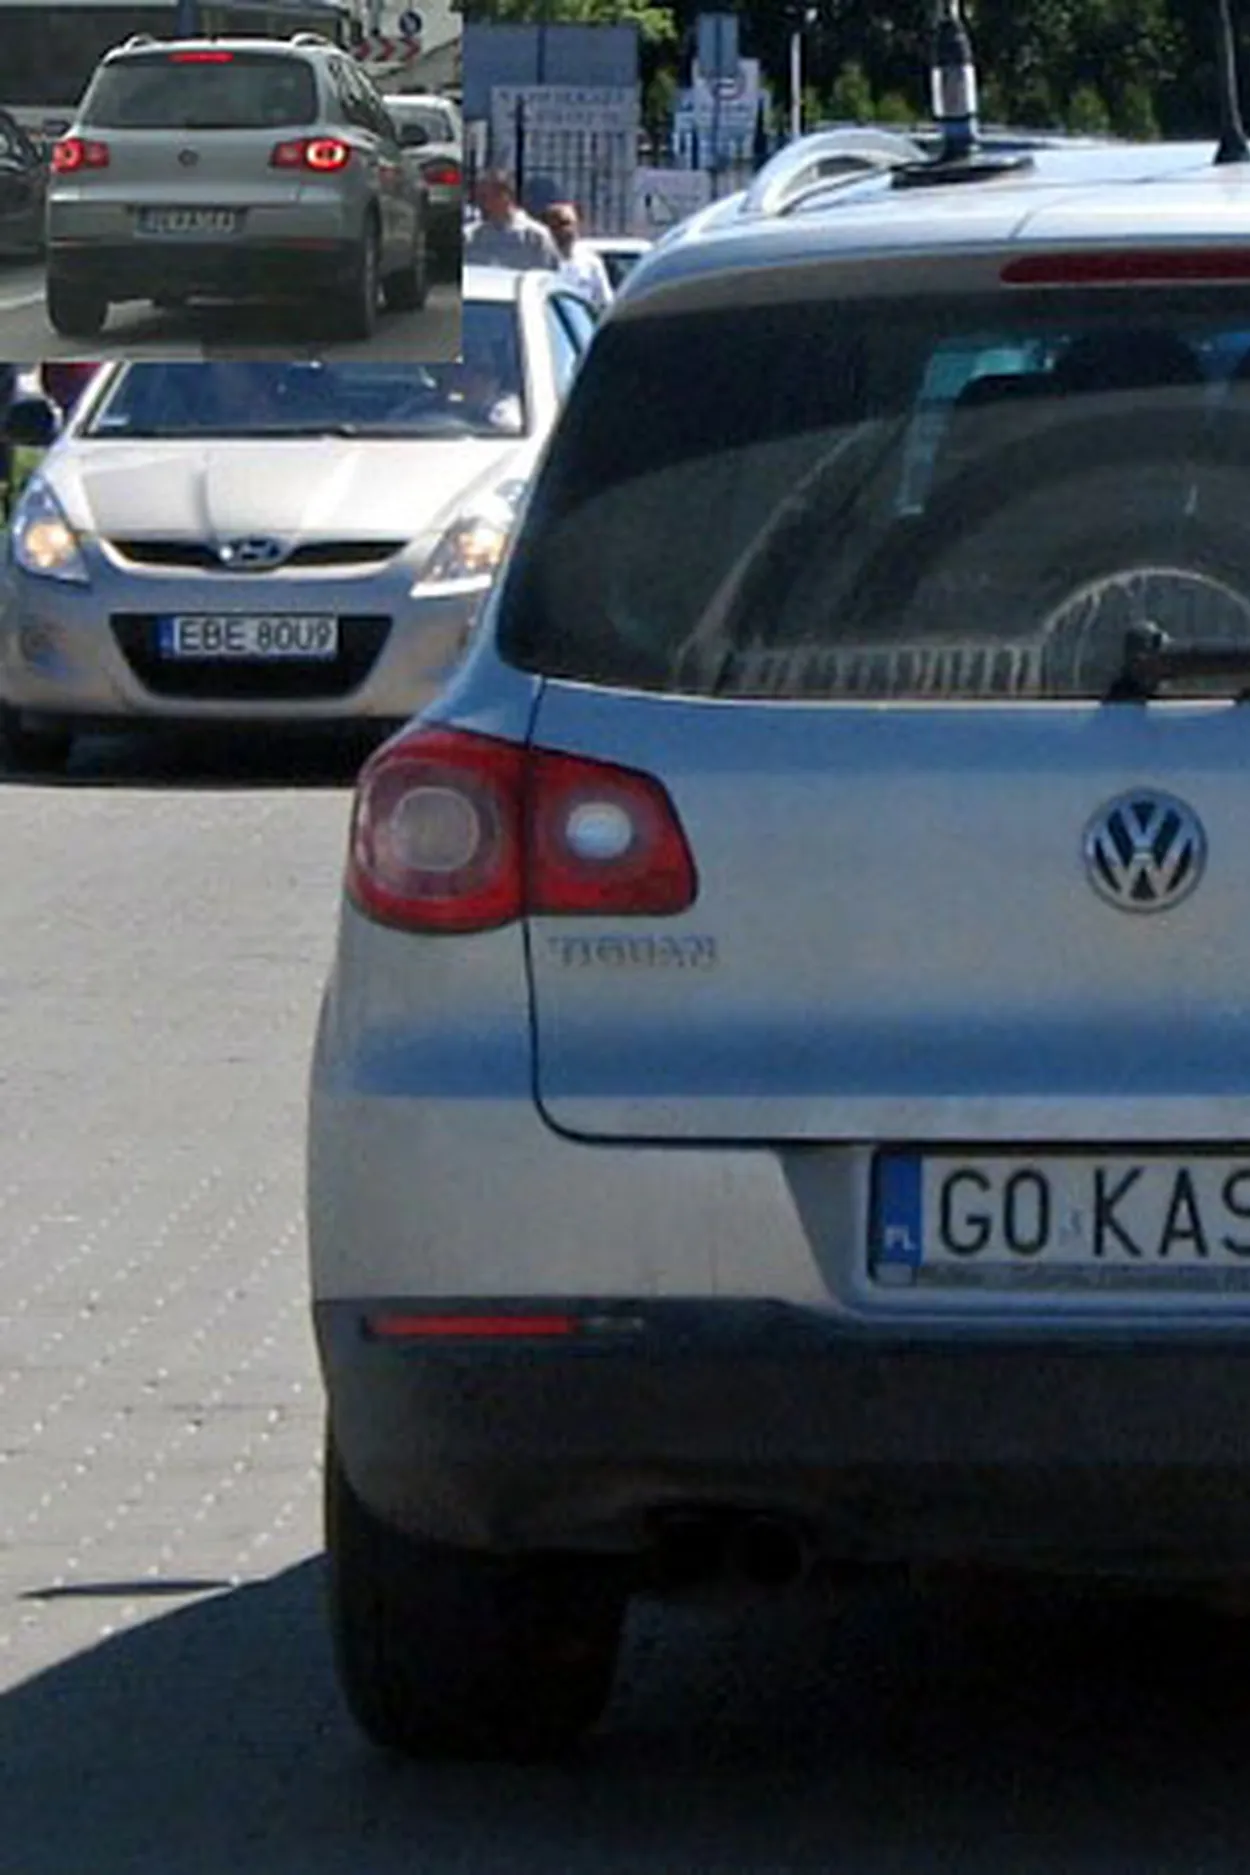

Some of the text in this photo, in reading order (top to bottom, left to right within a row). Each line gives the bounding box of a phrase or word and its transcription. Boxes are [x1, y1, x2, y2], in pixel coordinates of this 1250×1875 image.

[180, 619, 246, 650] EBE
[940, 1168, 1050, 1257] GO
[886, 1226, 916, 1251] PL
